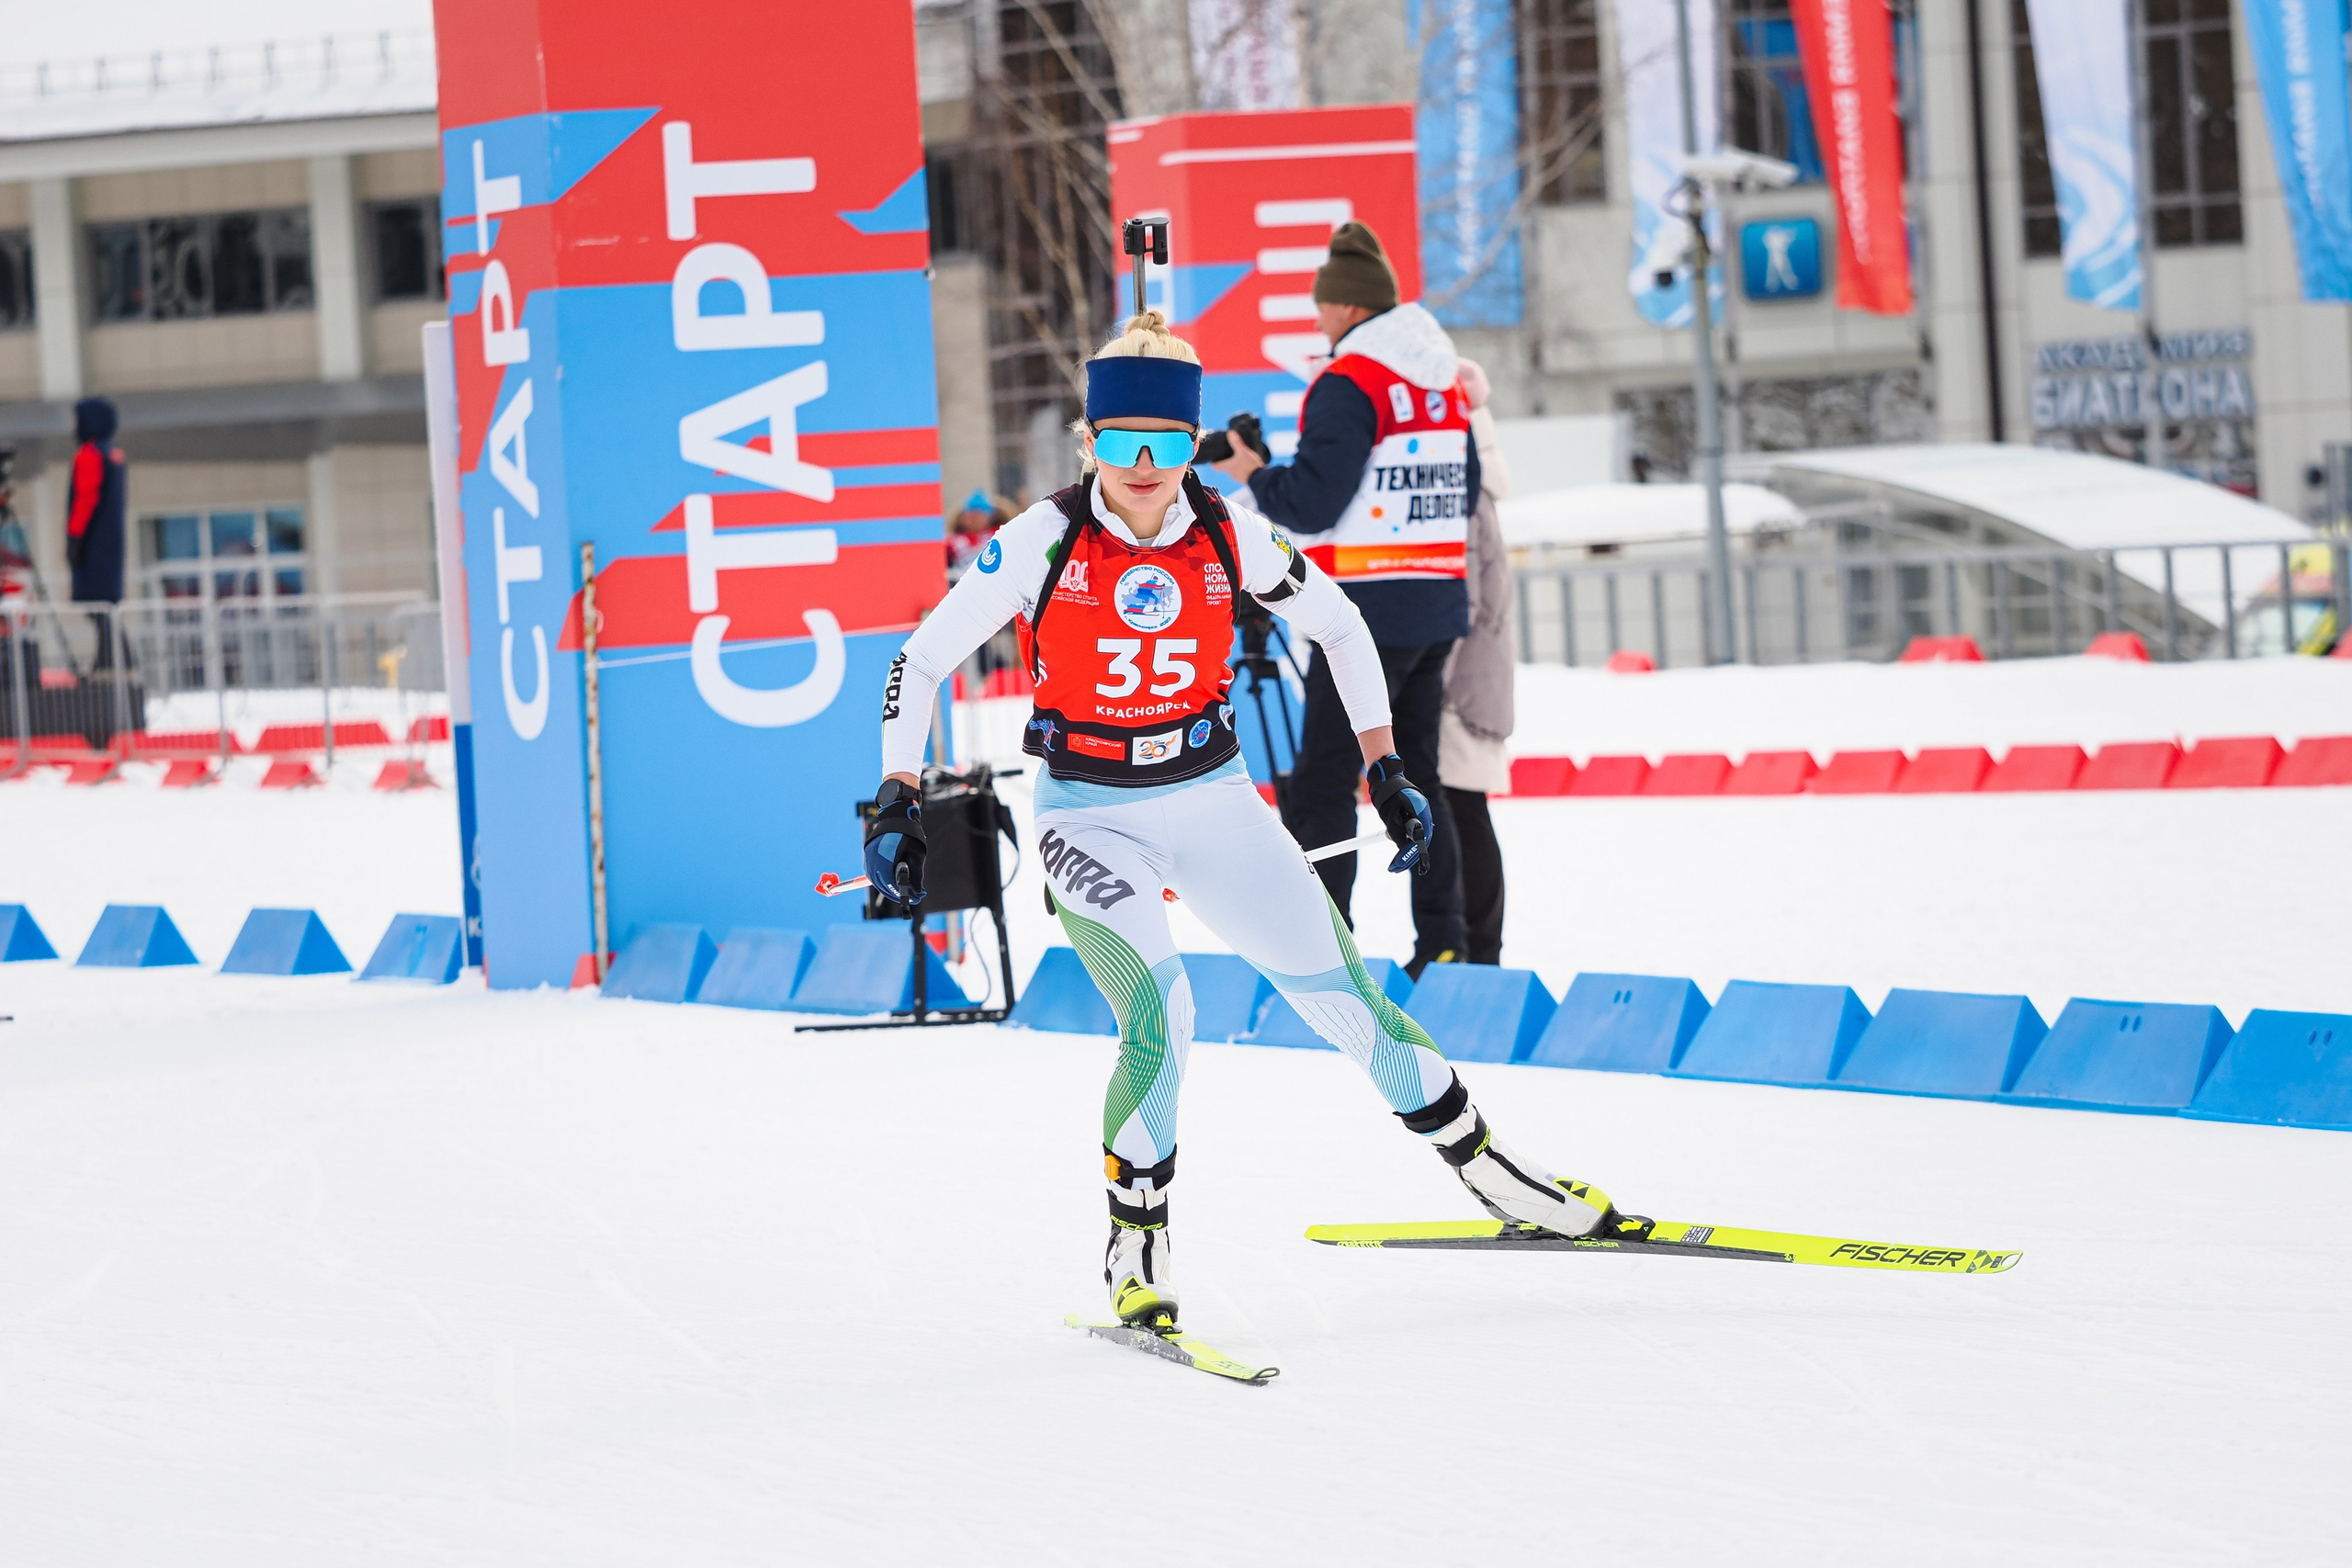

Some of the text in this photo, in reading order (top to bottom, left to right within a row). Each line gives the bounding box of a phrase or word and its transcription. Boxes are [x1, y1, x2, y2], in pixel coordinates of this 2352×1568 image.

[662, 120, 847, 728] СТАРТ
[472, 139, 549, 741] СТАРТ
[1095, 637, 1198, 699] 35
[1095, 699, 1192, 719] КРАСНОЯРСК
[1401, 843, 1419, 862] KINE
[1110, 1214, 1163, 1231] FISCHER
[1573, 1240, 1620, 1248] FISCHER
[1828, 1243, 1967, 1268] FISCHER
